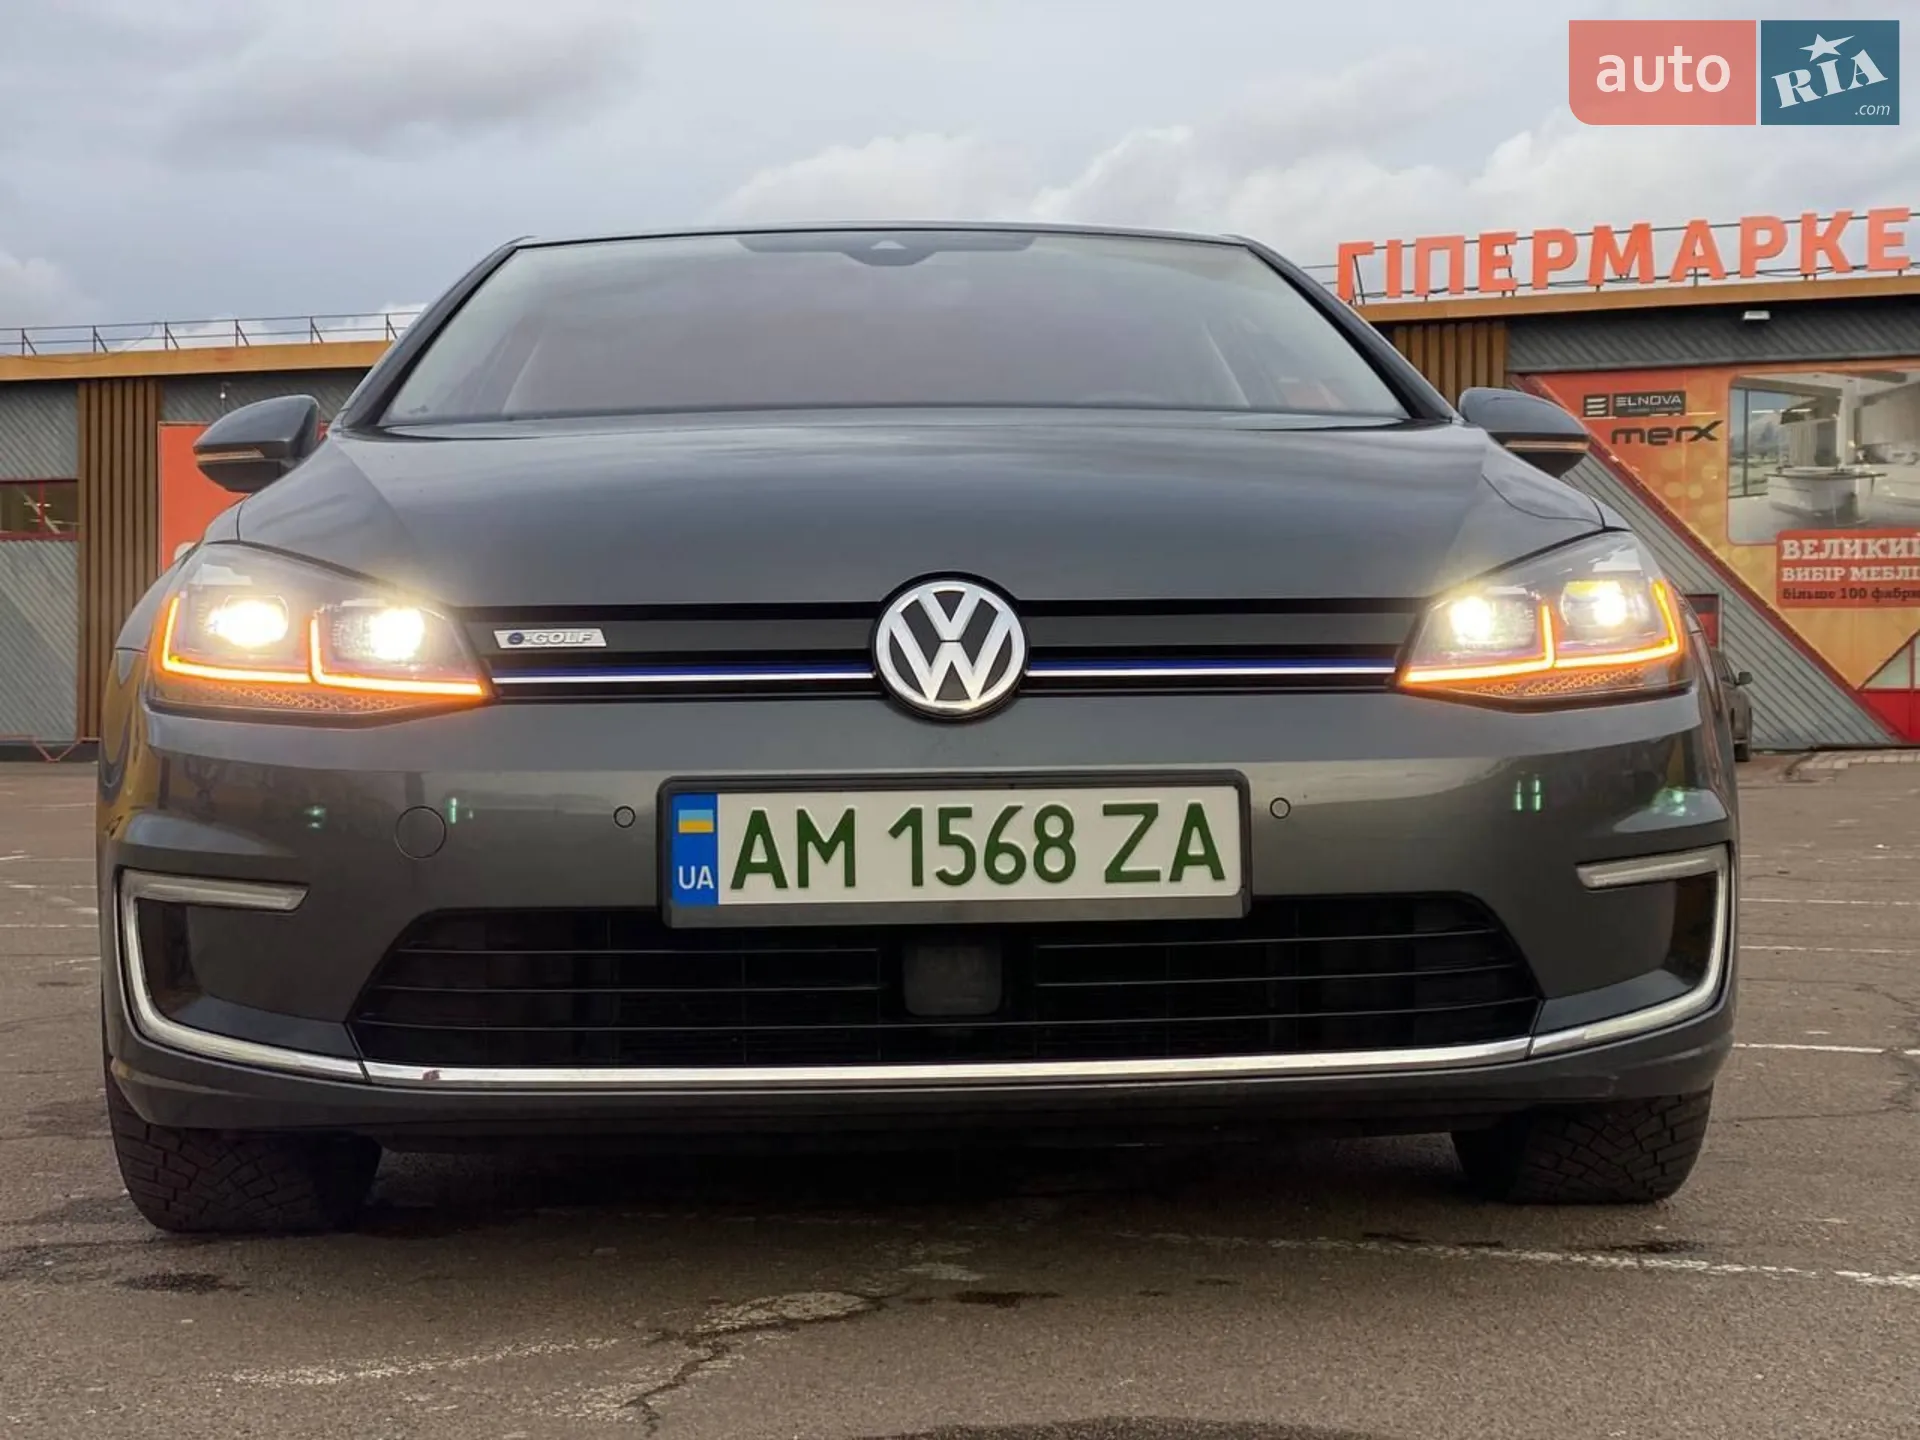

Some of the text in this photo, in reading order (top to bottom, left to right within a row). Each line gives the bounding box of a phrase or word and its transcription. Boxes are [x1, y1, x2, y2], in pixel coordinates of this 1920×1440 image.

[1337, 207, 1911, 301] ГІПЕРМАРКЕ
[1616, 394, 1682, 407] ELNOVA
[1782, 566, 1846, 582] ВИБІР
[1841, 587, 1868, 600] 100
[730, 802, 1226, 890] AM 1568 ZA
[678, 865, 715, 890] UA
